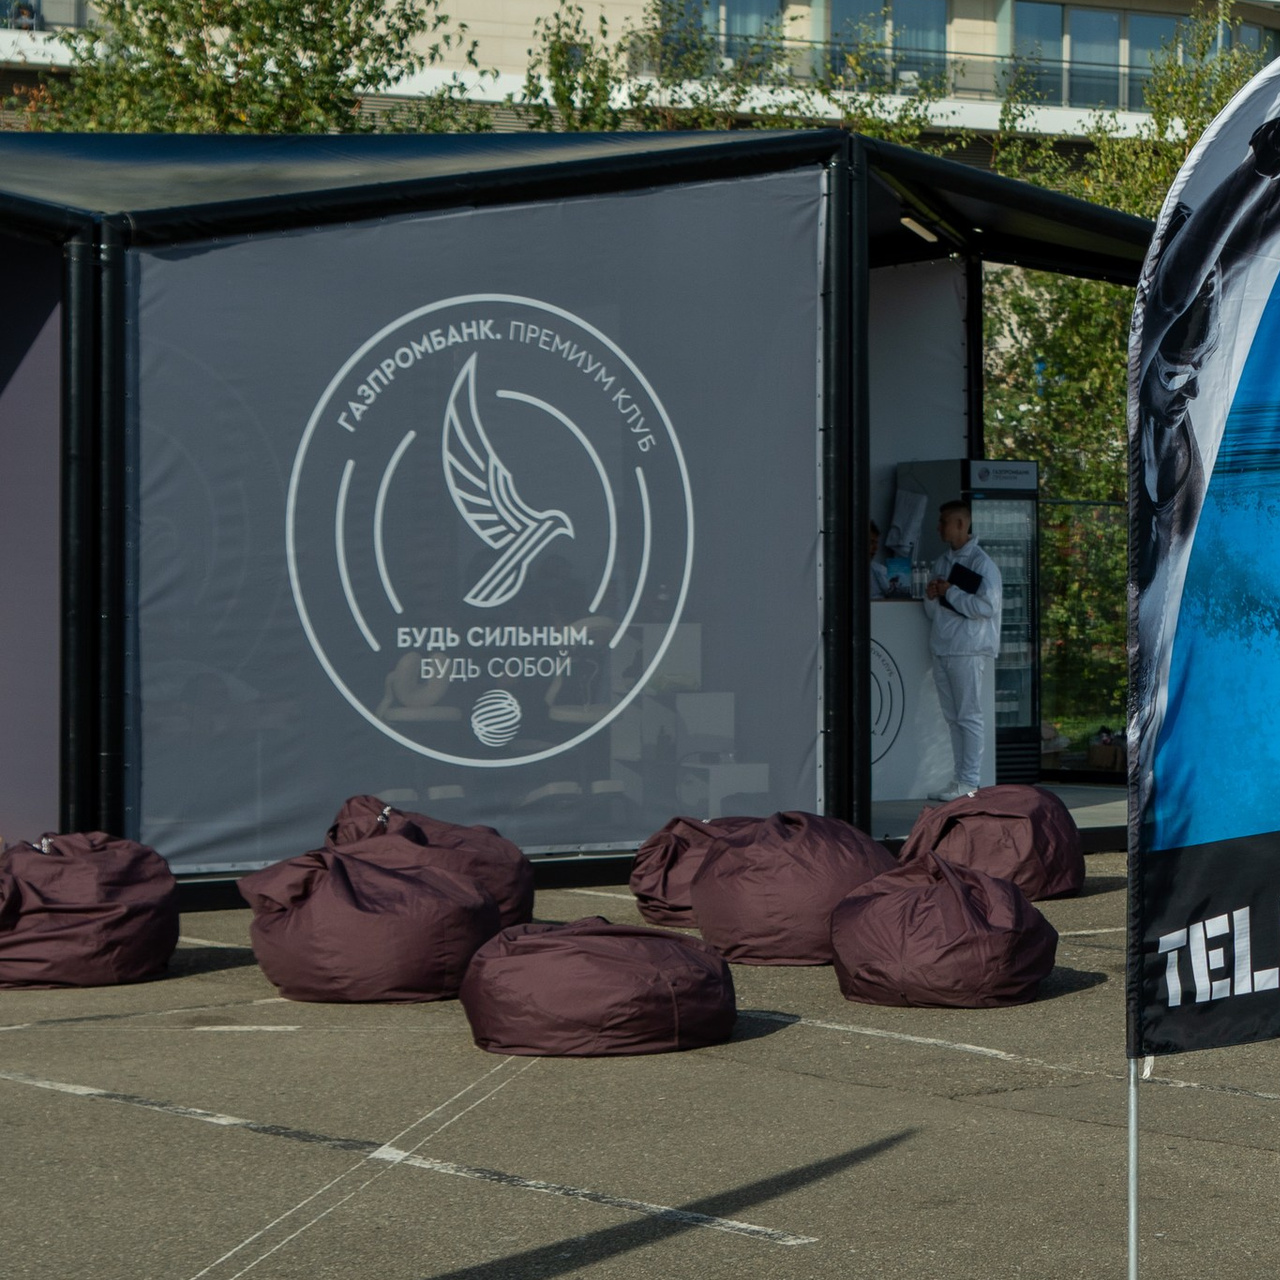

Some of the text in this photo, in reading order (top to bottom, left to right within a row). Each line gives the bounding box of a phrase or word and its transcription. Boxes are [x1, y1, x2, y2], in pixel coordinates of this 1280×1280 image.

[337, 319, 657, 453] ГАЗПРОМБАНК. ПРЕМИУМ КЛУБ
[397, 626, 594, 651] БУДЬ СИЛЬНЫМ.
[420, 650, 572, 682] БУДЬ СОБОЙ
